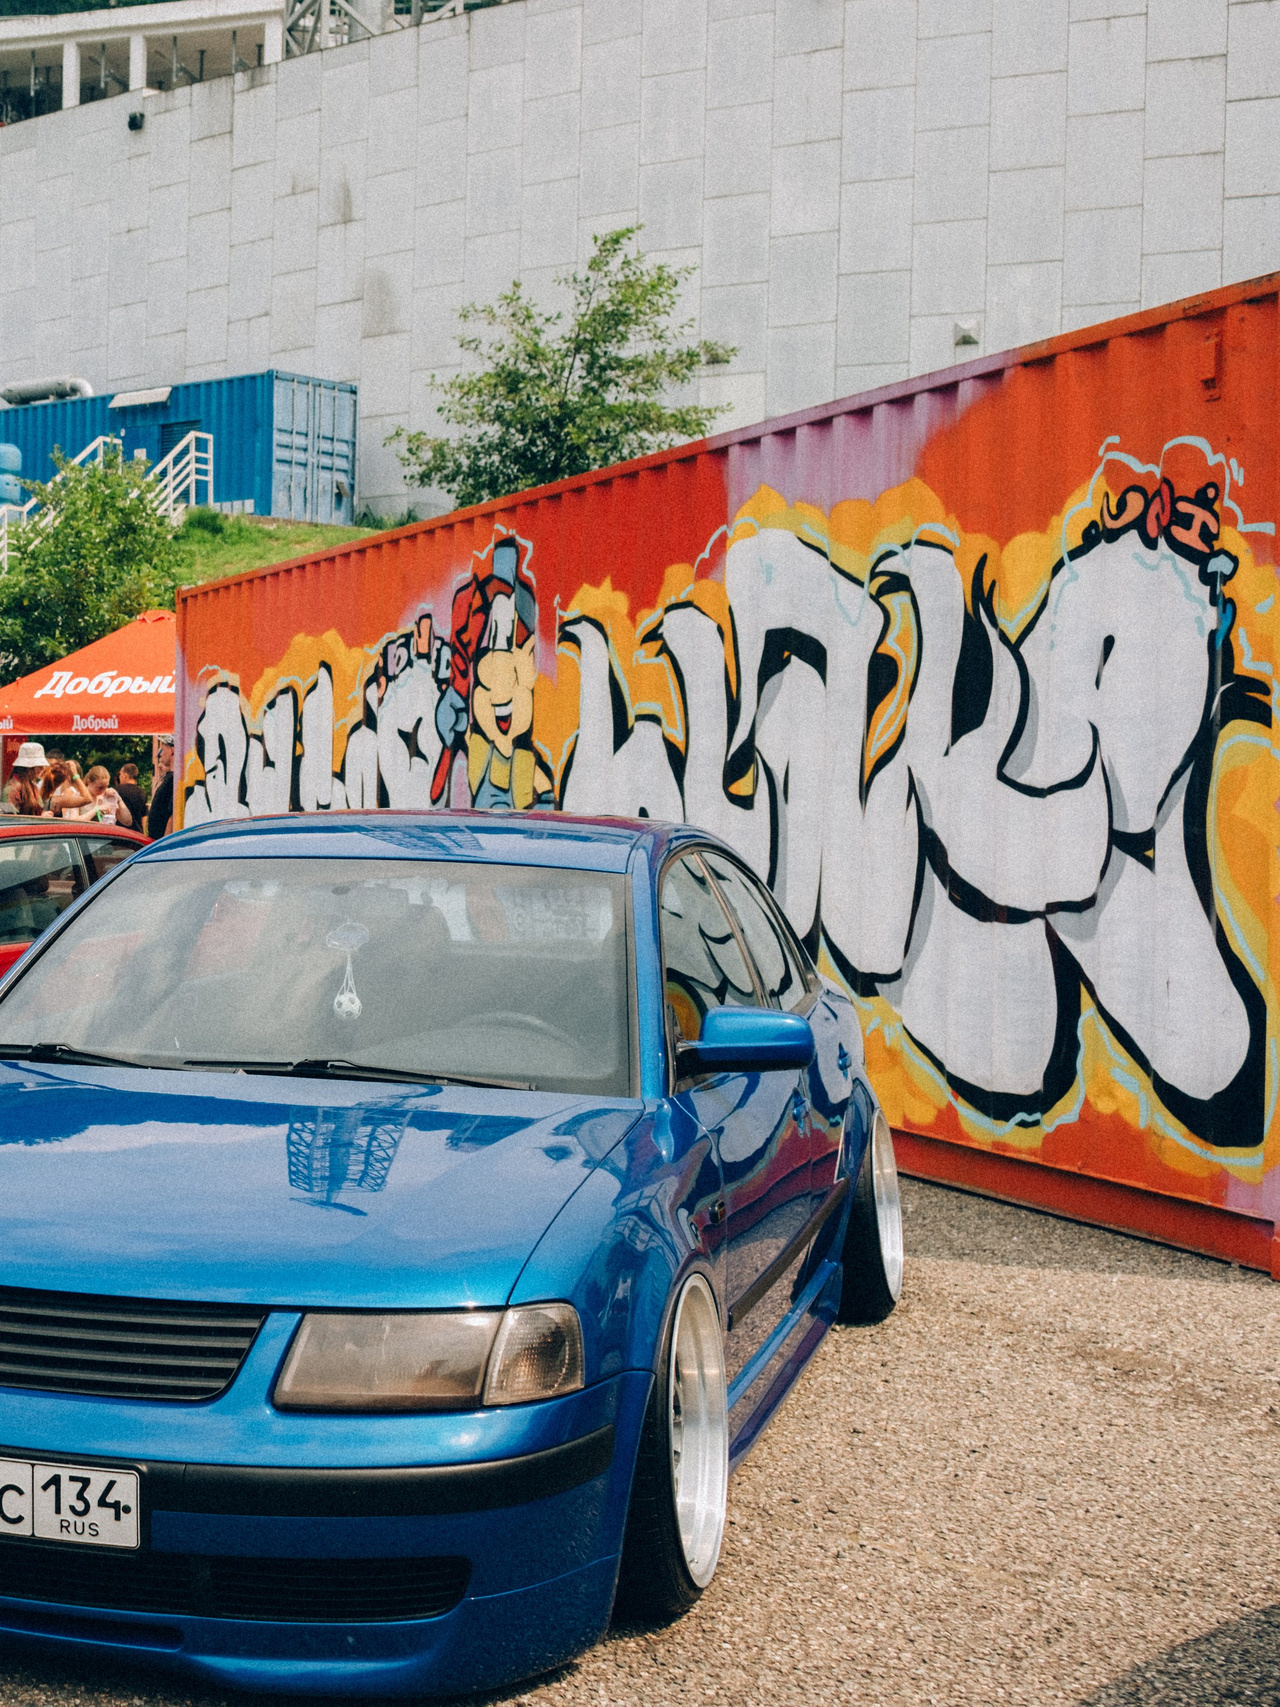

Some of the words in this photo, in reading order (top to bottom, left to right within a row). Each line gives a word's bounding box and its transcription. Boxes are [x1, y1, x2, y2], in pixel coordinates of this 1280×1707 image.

[71, 714, 119, 731] Добрый
[40, 1473, 122, 1522] 134
[60, 1518, 100, 1537] RUS
